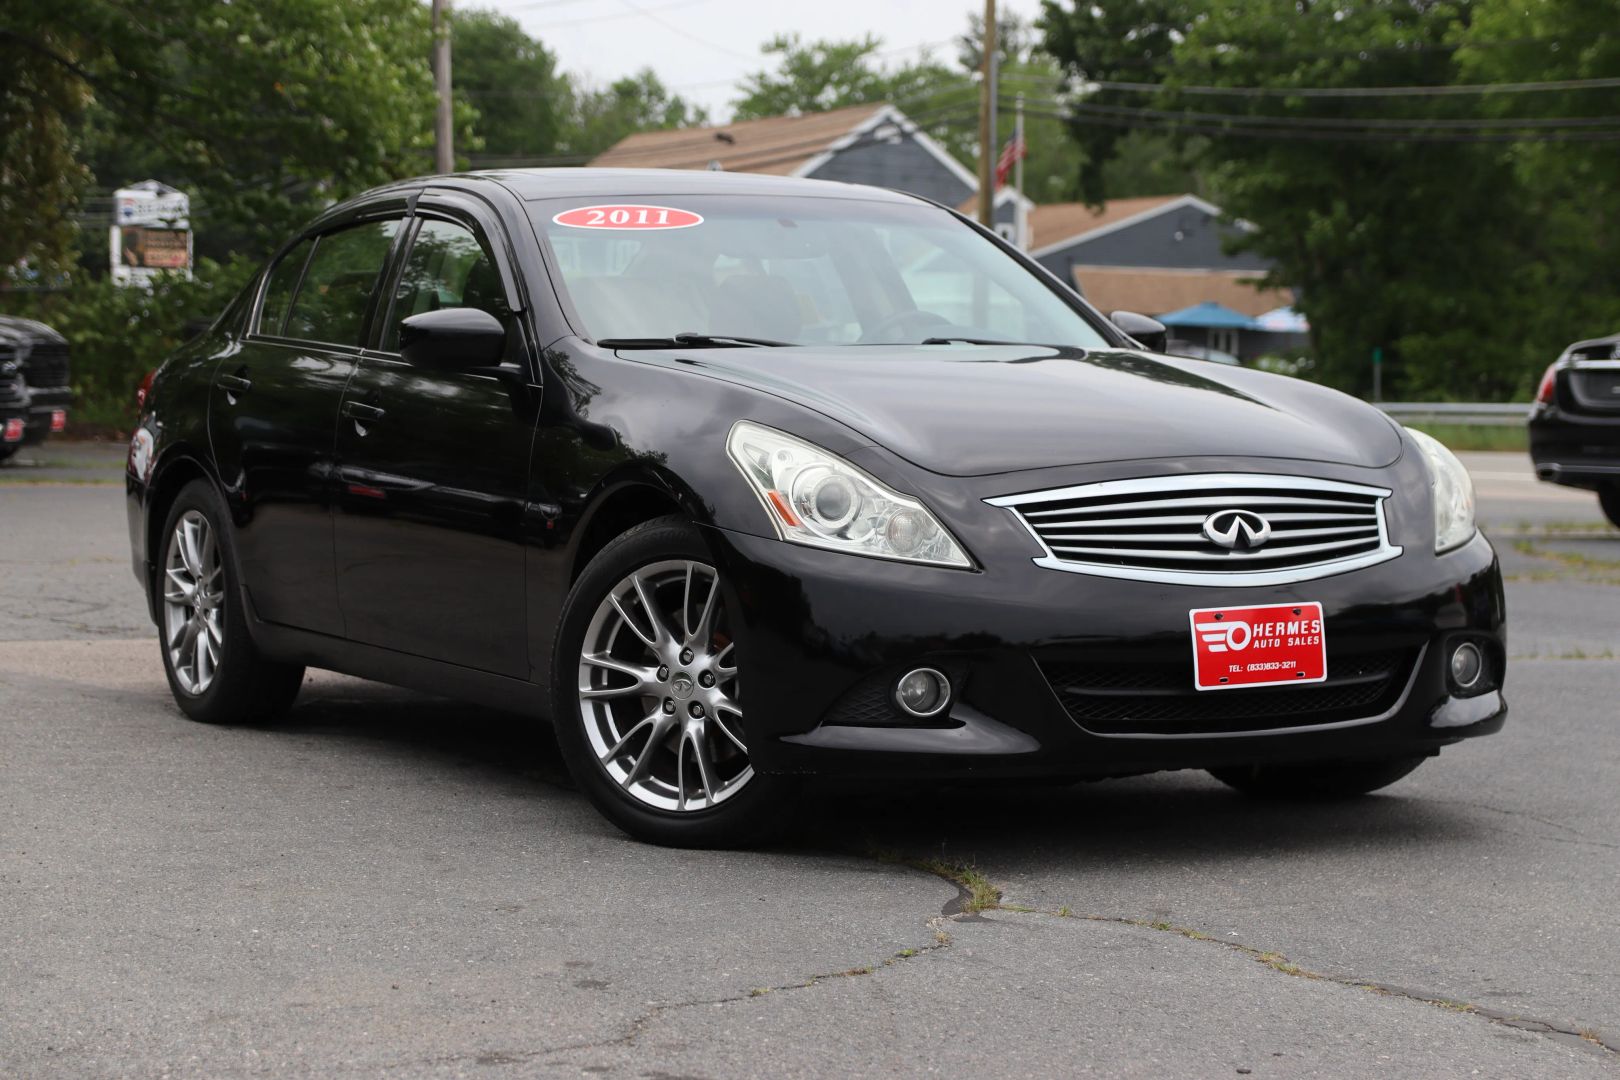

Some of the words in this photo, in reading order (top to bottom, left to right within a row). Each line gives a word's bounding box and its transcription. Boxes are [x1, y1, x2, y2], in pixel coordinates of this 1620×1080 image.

[586, 209, 670, 225] 2011
[1253, 620, 1321, 637] HERMES
[1253, 638, 1281, 649] AUTO
[1287, 636, 1320, 647] SALES
[1229, 664, 1243, 673] TEL:
[1247, 661, 1297, 672] (833)833-3211
